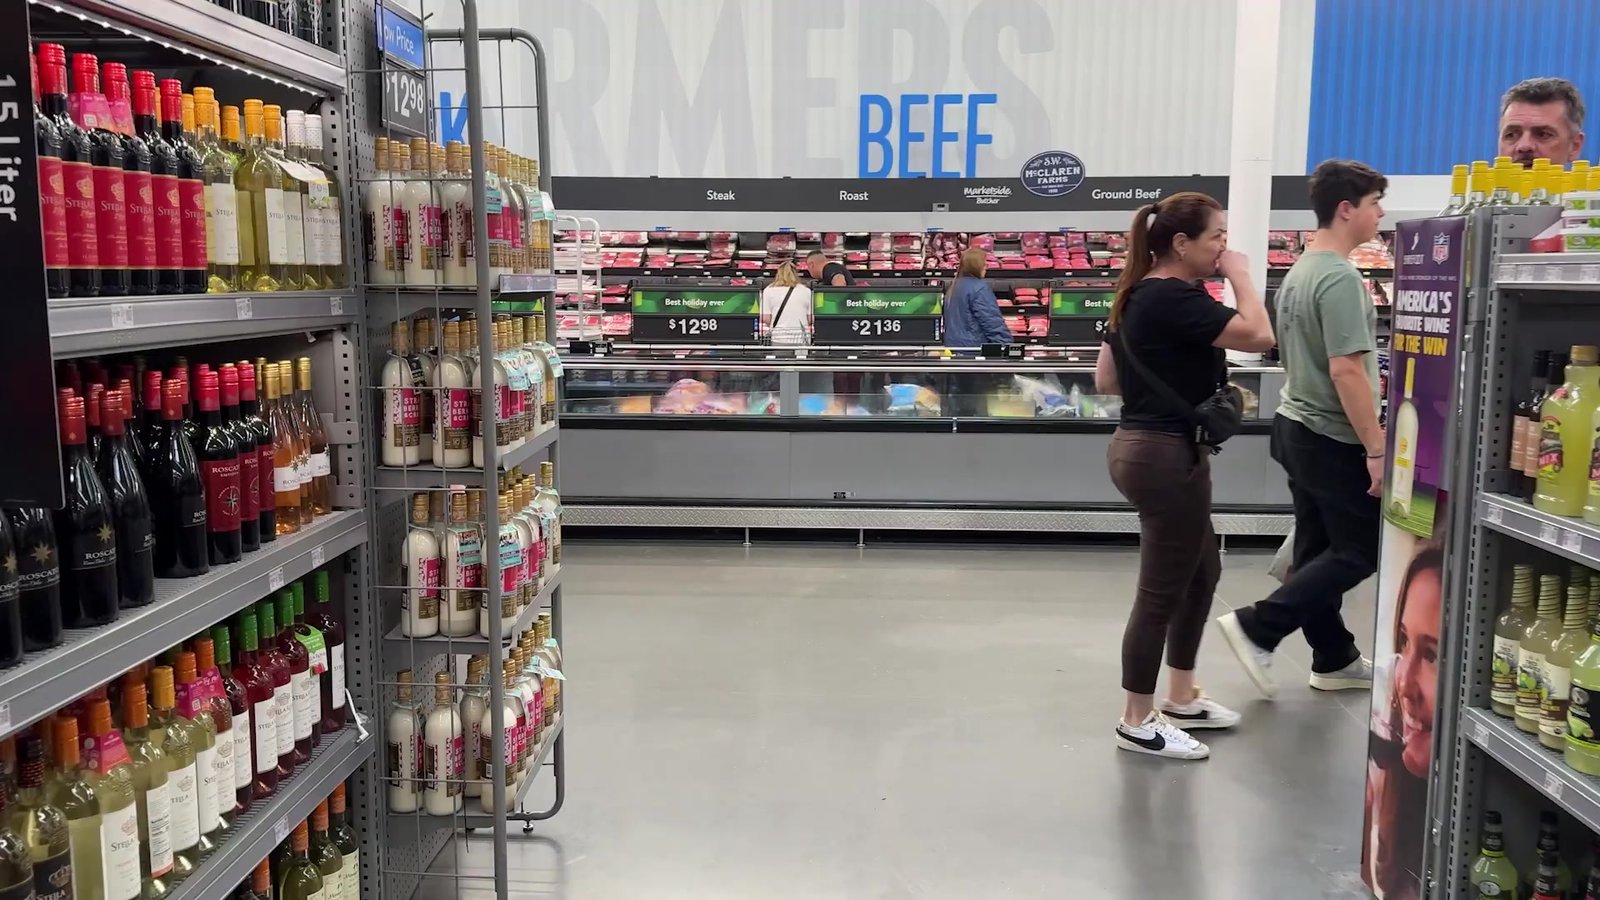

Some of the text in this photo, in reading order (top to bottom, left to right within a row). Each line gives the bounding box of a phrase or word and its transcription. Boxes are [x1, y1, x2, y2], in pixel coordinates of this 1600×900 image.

[396, 25, 414, 55] Price
[858, 94, 997, 178] BEEF
[1037, 176, 1068, 184] FARMS
[706, 190, 736, 201] Steak
[839, 190, 869, 201] Roast
[1092, 188, 1162, 200] Ground Beef
[665, 298, 681, 306] Best
[682, 298, 708, 308] holiday
[846, 299, 862, 307] Best
[863, 299, 889, 309] holiday
[1084, 299, 1101, 307] Best
[1396, 289, 1453, 314] AMERICA'S
[1424, 316, 1450, 334] WINE
[1405, 335, 1421, 354] THE
[1423, 336, 1448, 357] WIN
